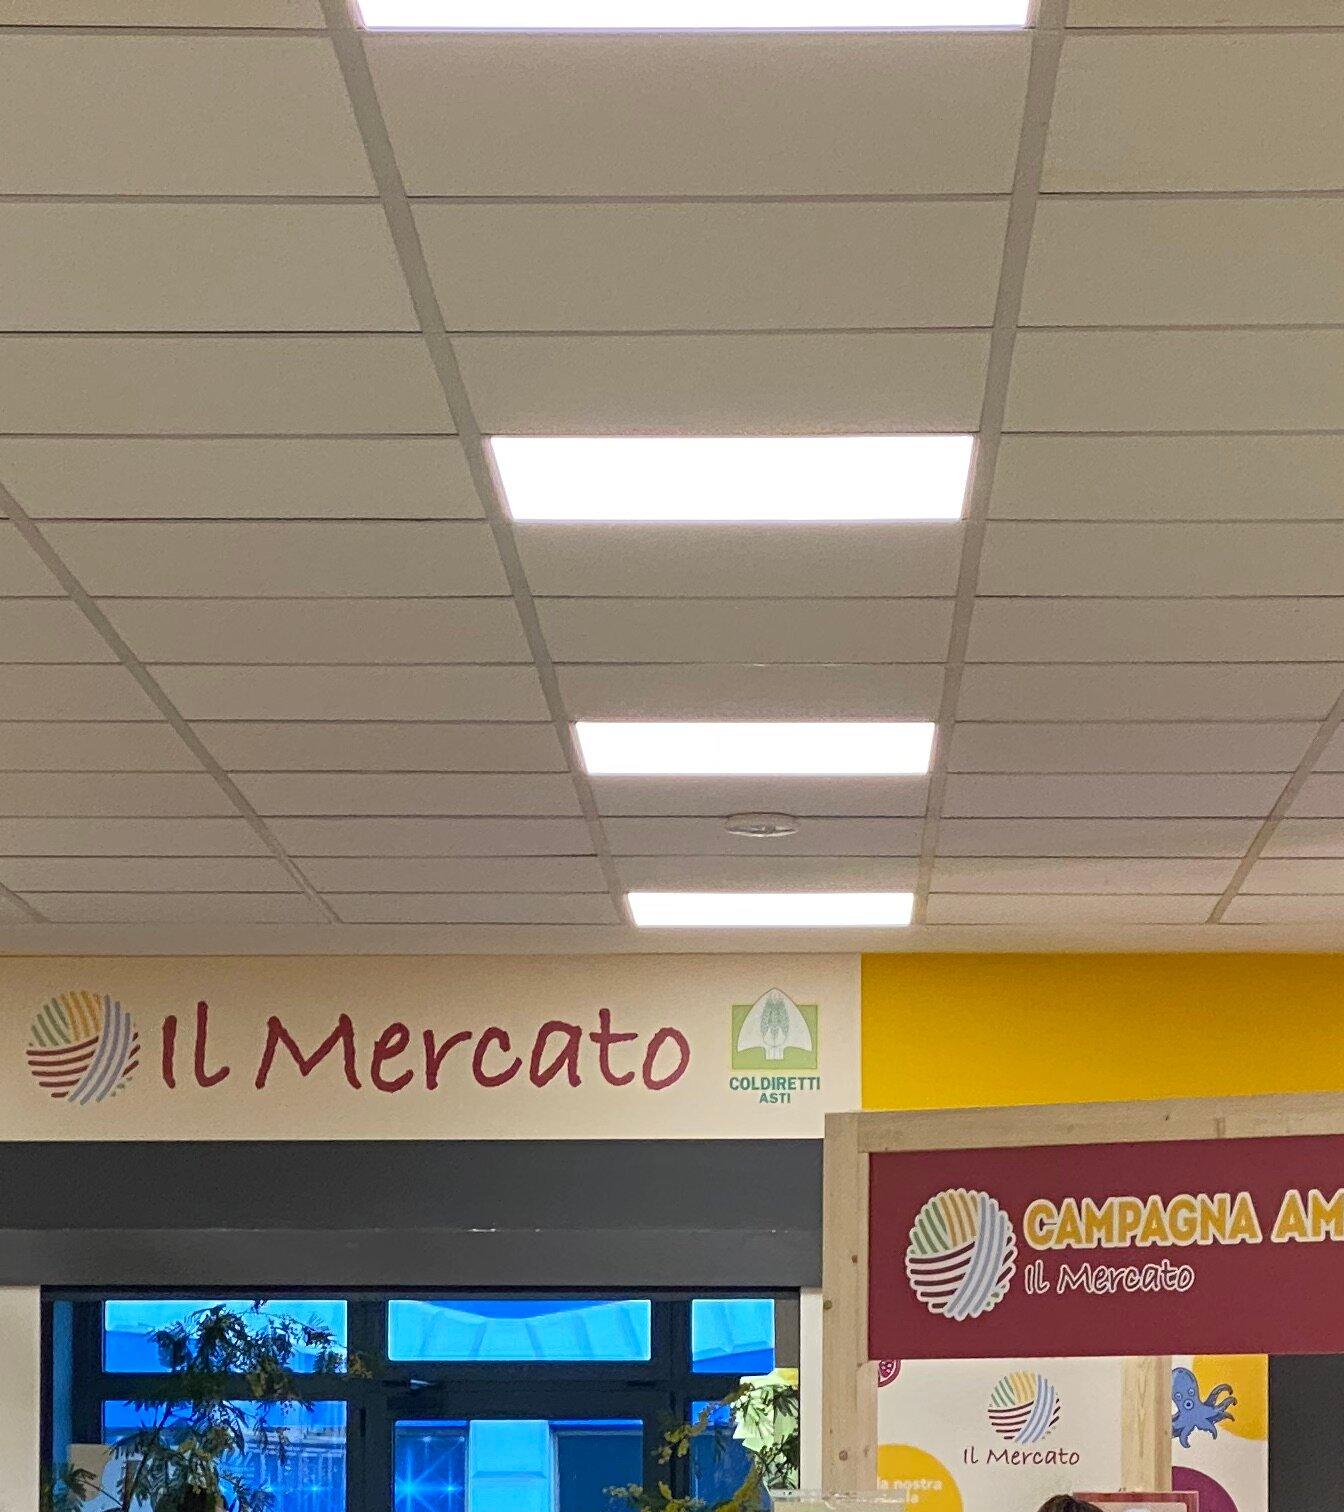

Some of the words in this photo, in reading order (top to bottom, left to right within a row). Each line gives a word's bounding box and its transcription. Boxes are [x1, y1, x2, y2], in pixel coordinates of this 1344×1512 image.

[162, 1001, 231, 1089] Il
[255, 1008, 690, 1093] Mercato
[729, 1076, 821, 1091] COLDIRETTI
[758, 1093, 792, 1104] ASTI
[1023, 1191, 1263, 1250] CAMPAGNA
[1024, 1260, 1051, 1294] Il
[1057, 1259, 1195, 1294] Mercato
[964, 1446, 979, 1465] Il
[987, 1447, 1081, 1466] Mercato
[894, 1479, 943, 1490] nostra
